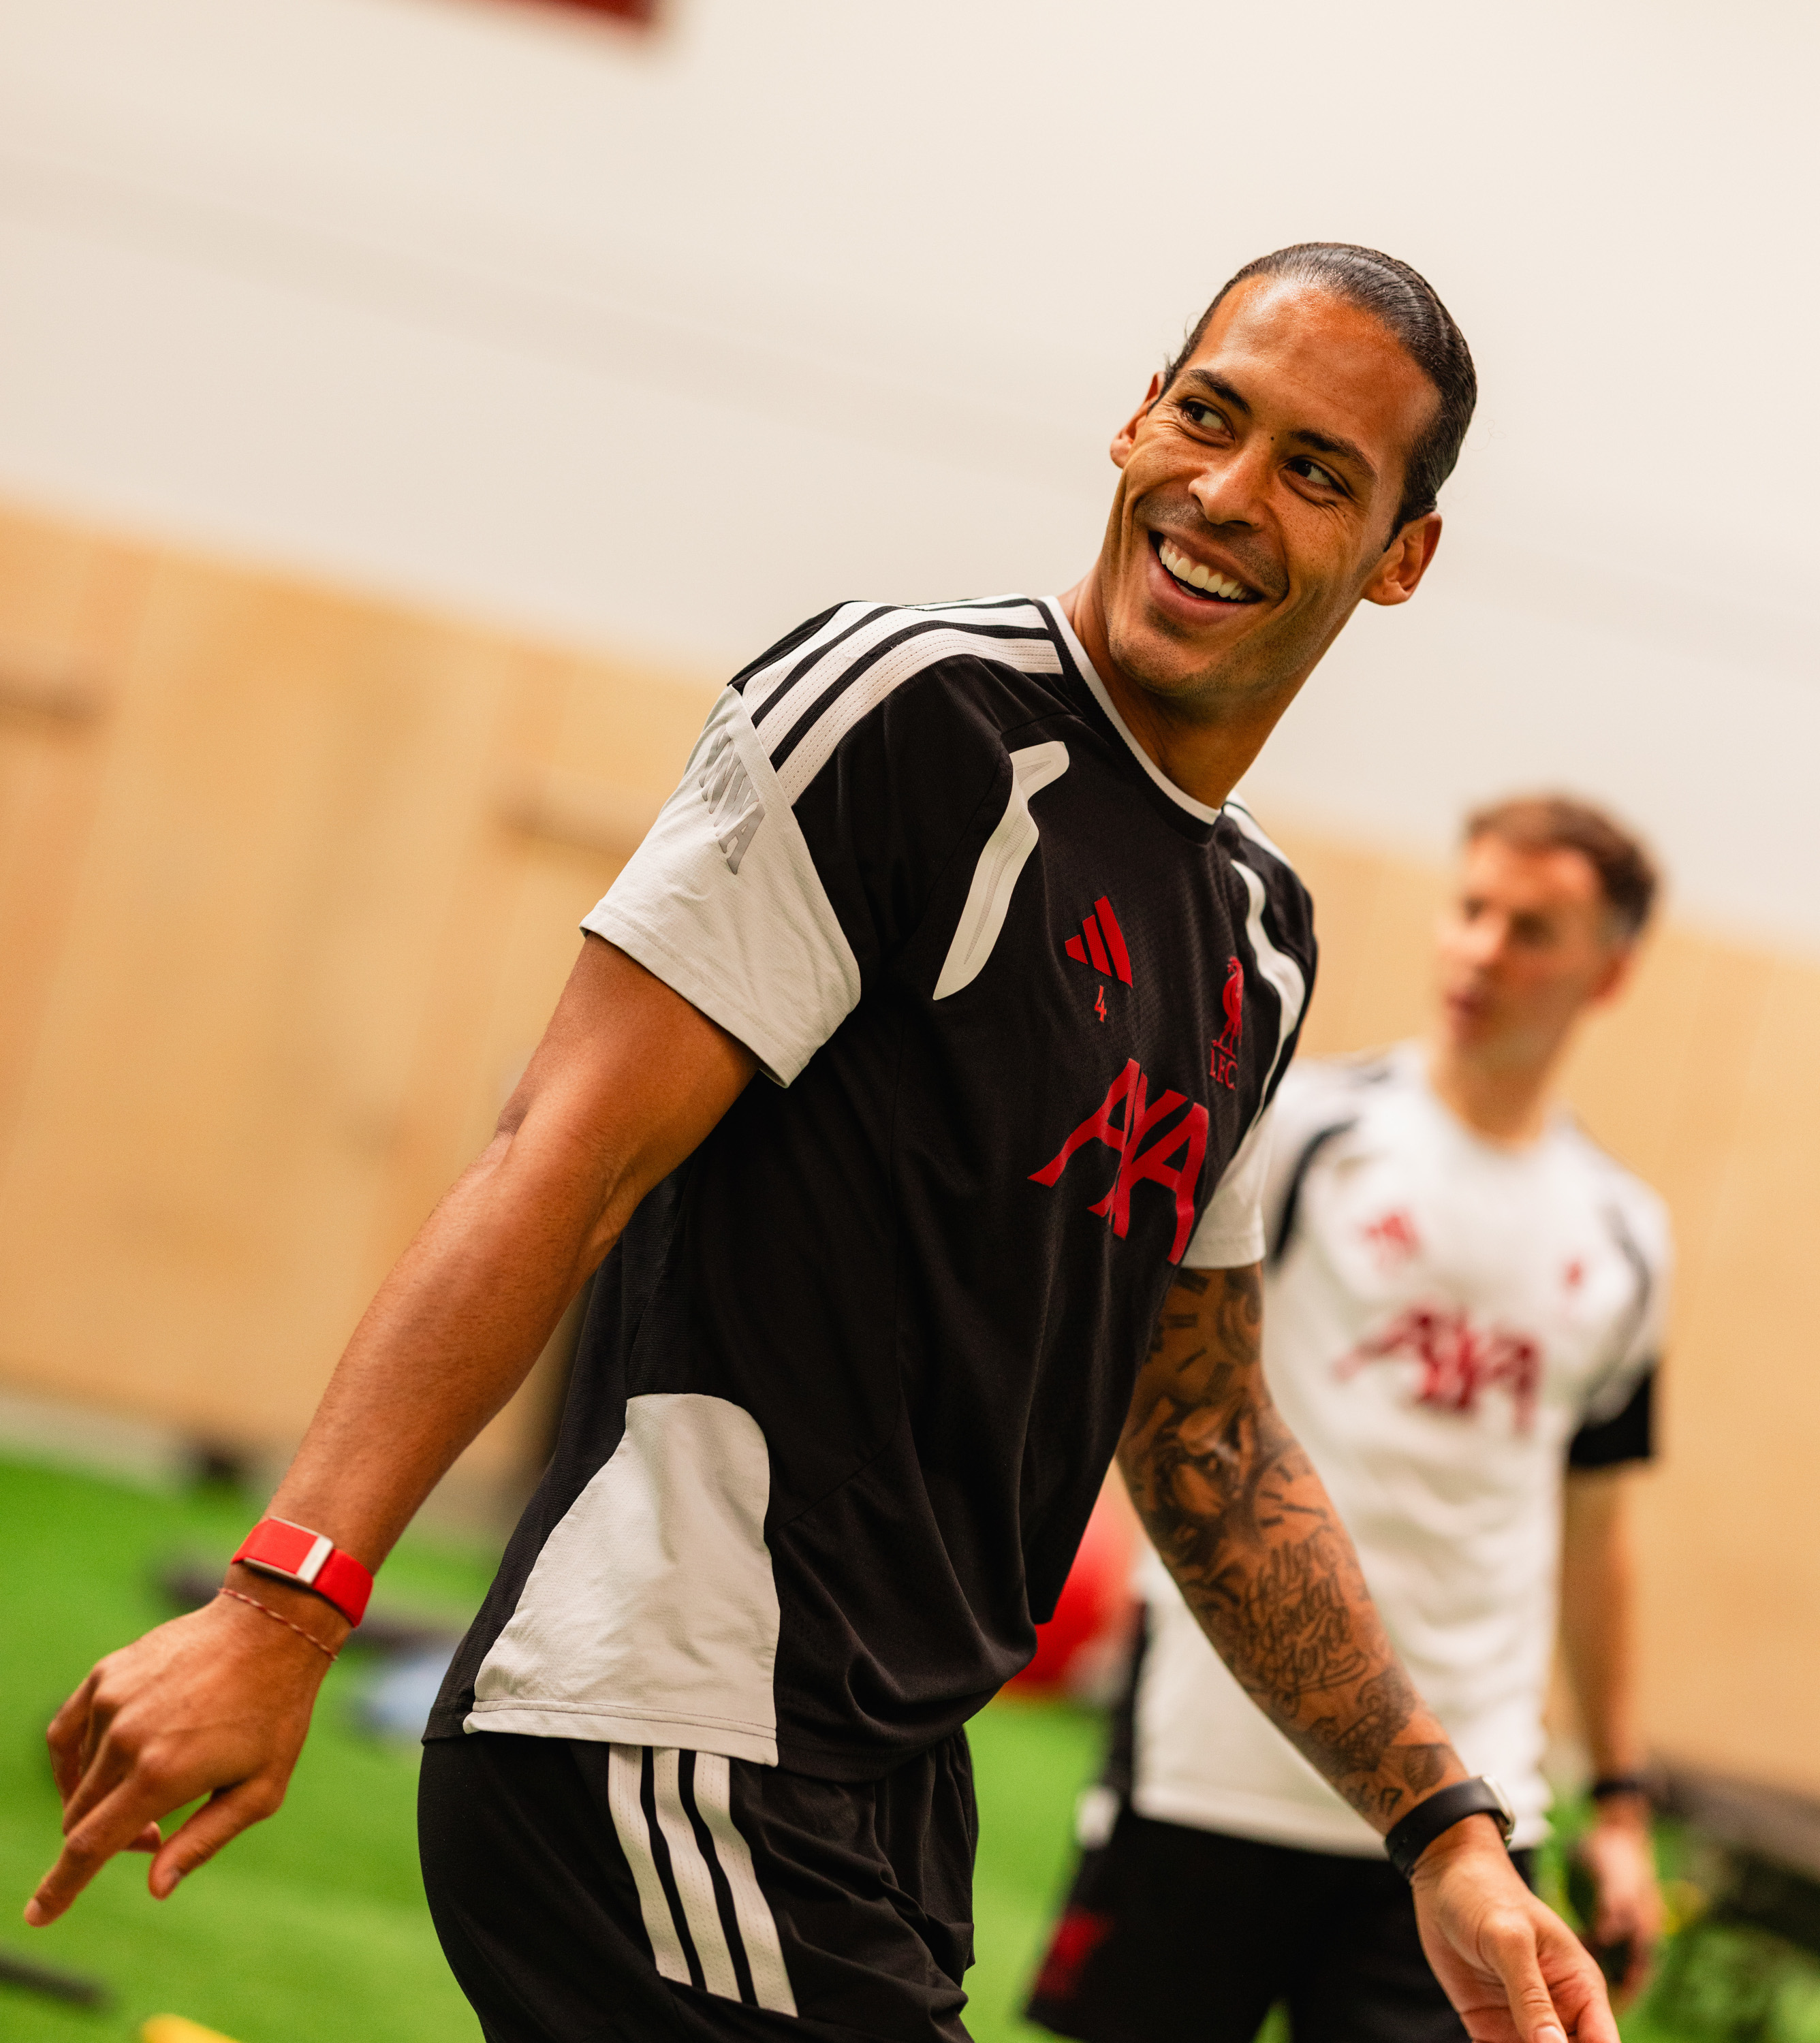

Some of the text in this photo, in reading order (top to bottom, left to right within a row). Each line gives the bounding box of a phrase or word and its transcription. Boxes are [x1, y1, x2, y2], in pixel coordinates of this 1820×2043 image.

[698, 724, 766, 875] YNWA
[1094, 985, 1107, 1022] 4
[1209, 1049, 1238, 1090] LFC
[1027, 1058, 1209, 1265] AXA
